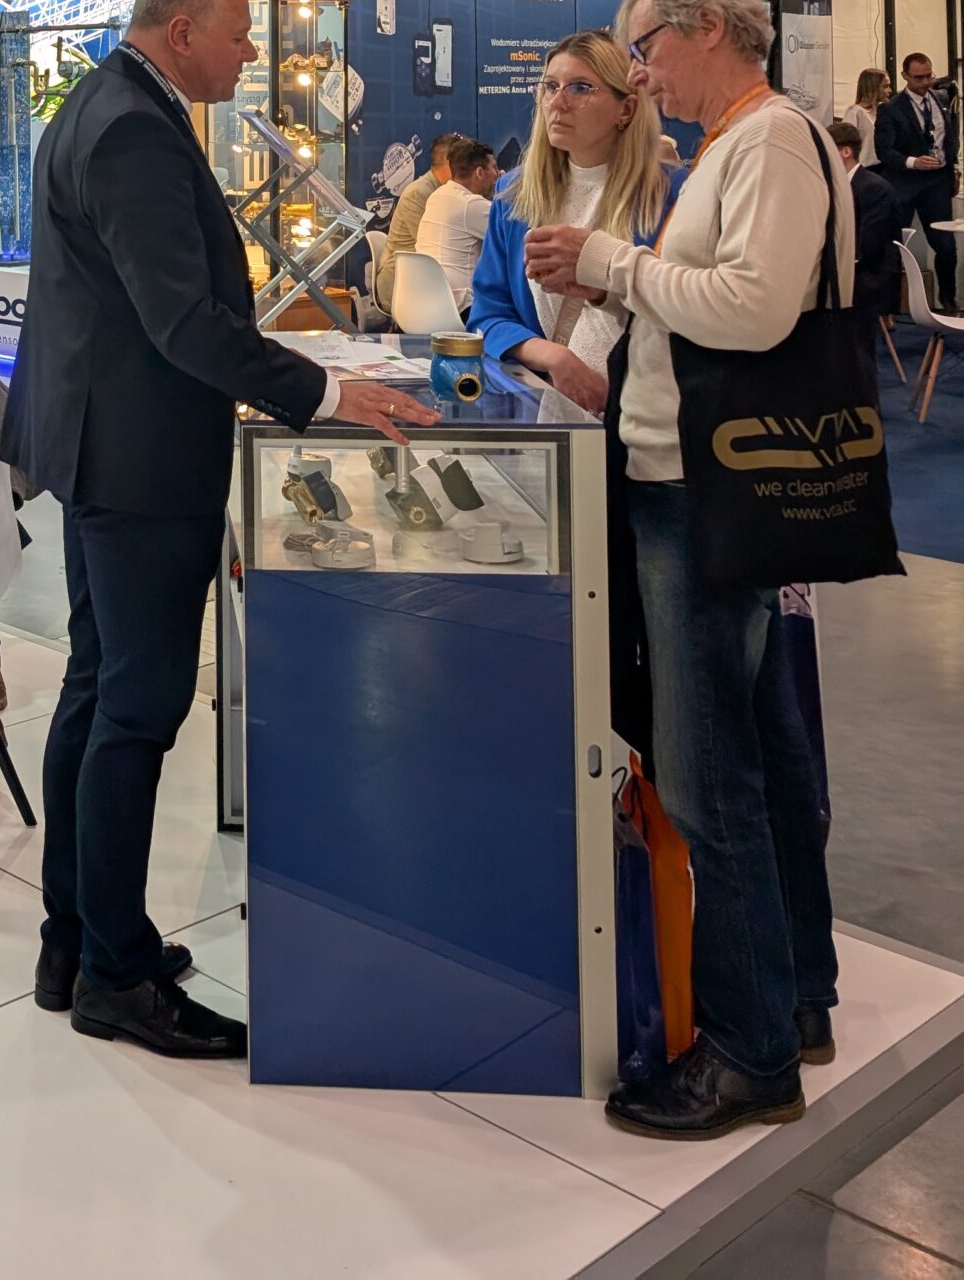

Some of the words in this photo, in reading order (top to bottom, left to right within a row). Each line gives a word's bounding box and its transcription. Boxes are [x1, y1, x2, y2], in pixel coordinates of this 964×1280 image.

[479, 86, 510, 94] METERING
[753, 481, 783, 497] we
[786, 478, 835, 497] clean
